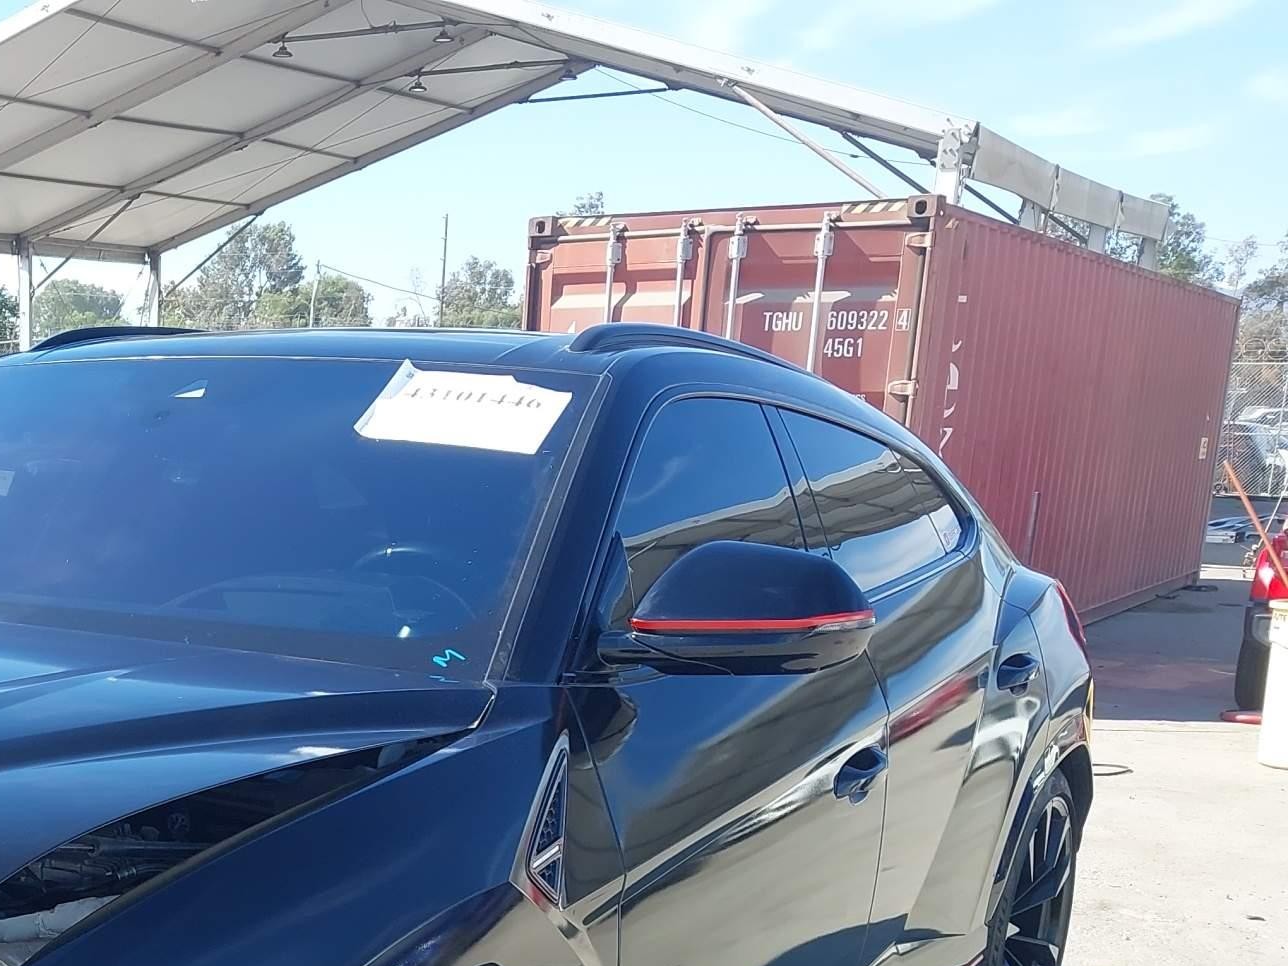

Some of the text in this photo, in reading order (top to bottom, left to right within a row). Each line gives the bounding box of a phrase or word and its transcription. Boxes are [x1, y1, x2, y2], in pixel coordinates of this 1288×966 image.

[763, 310, 909, 331] TGHU 609322 4
[823, 337, 863, 358] 45G1
